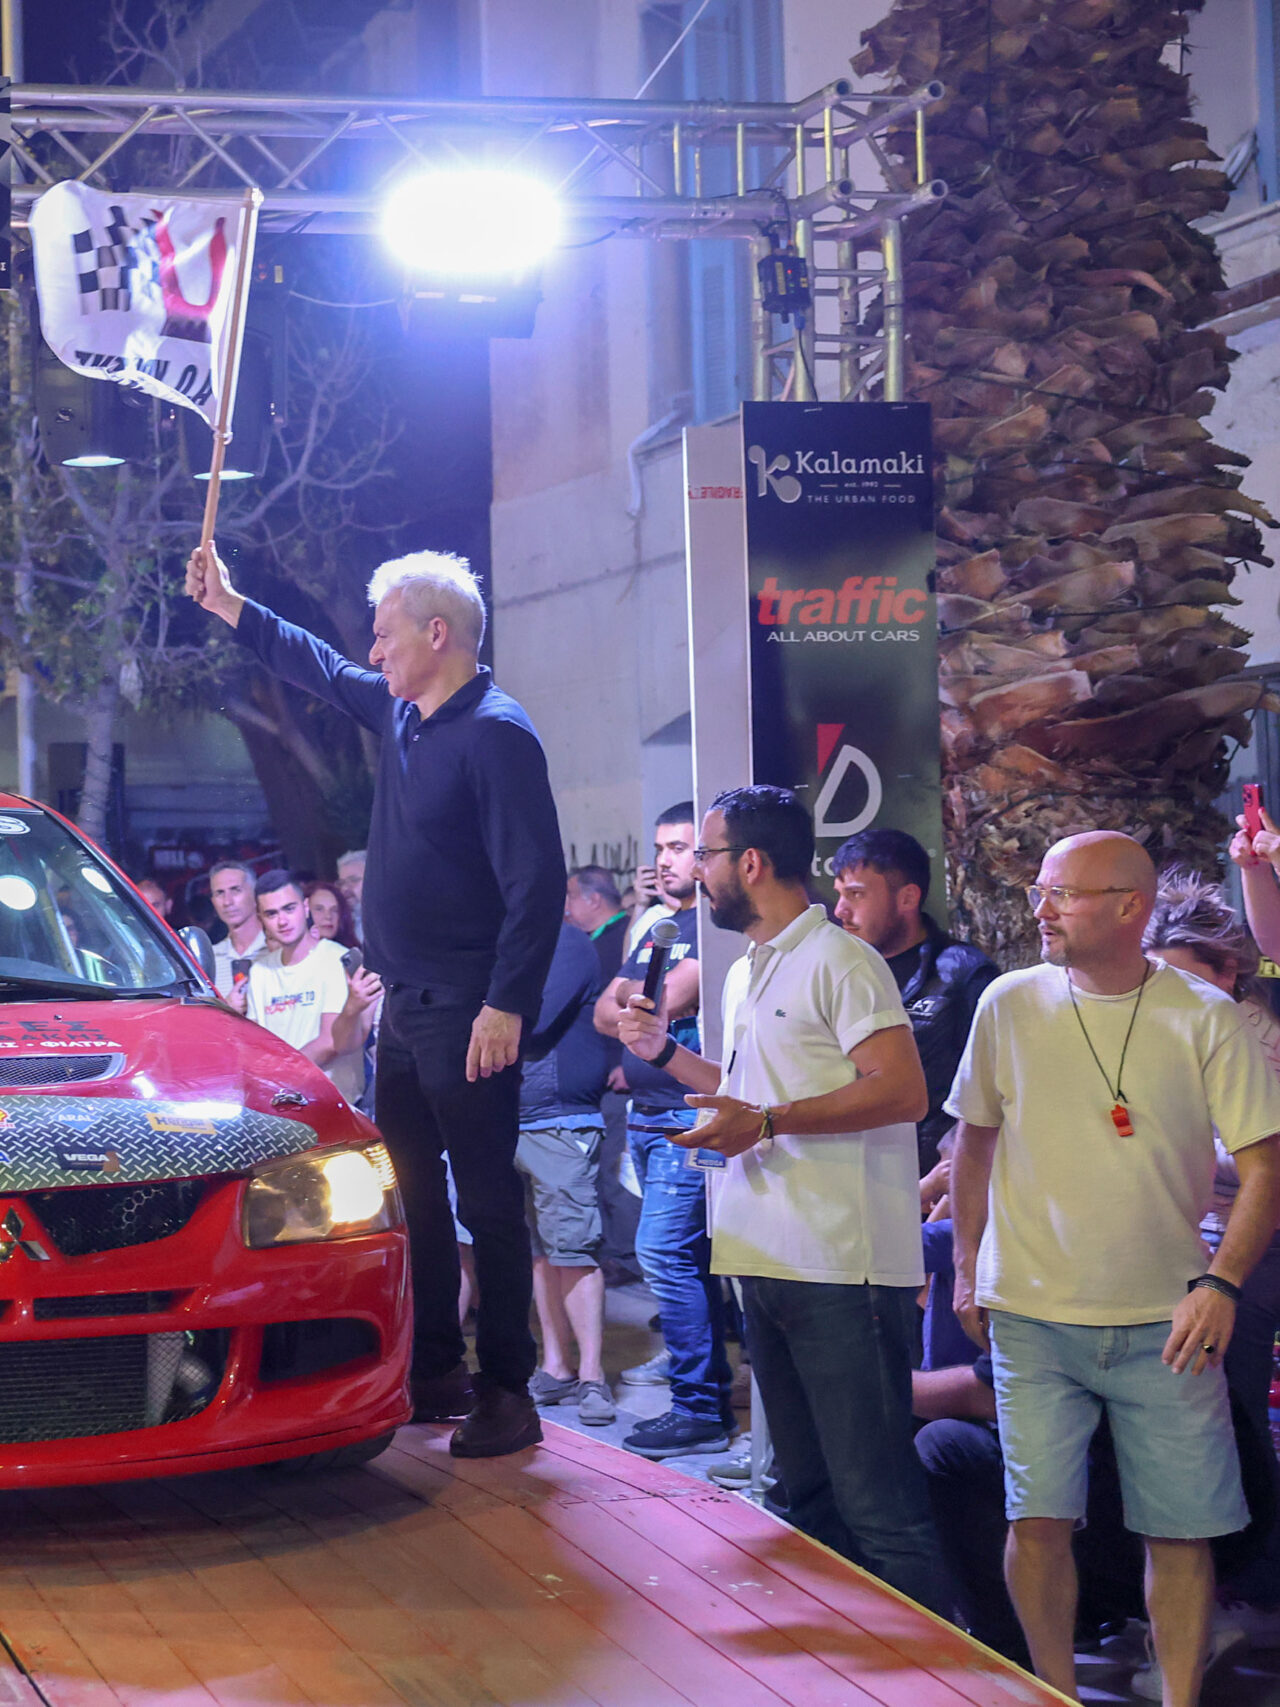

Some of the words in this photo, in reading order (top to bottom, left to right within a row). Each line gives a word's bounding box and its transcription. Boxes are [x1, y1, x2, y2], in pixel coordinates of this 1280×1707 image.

[795, 451, 924, 474] Kalamaki
[808, 495, 829, 503] THE
[836, 495, 876, 503] URBAN
[882, 495, 916, 503] FOOD
[757, 576, 927, 625] traffic
[766, 630, 800, 642] ALL
[803, 630, 866, 642] ABOUT
[871, 630, 920, 642] CARS
[63, 1153, 110, 1161] VEGA
